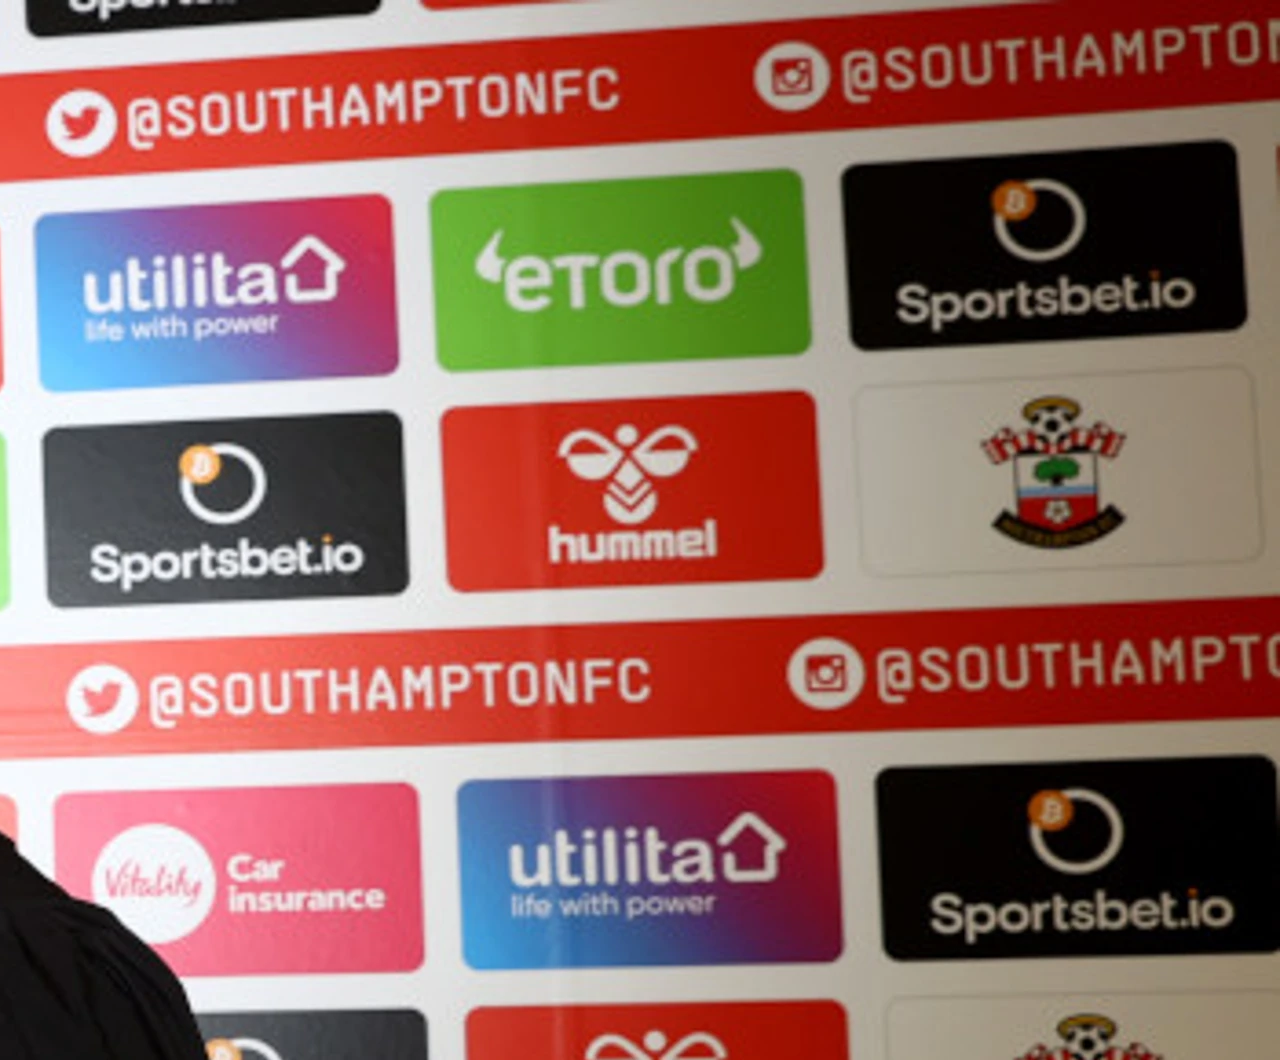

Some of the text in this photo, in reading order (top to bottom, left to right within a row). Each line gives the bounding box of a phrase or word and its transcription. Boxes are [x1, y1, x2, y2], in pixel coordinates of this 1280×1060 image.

[128, 67, 620, 149] @SOUTHAMPTONFC
[84, 253, 277, 314] utilita
[897, 271, 1195, 331] Sportsbet.io
[84, 311, 278, 341] life with power
[90, 537, 363, 592] Sportsbet.io
[548, 518, 716, 563] hummel
[149, 657, 650, 729] @SOUTHAMPTONFC
[227, 853, 284, 882] Car
[509, 827, 714, 888] utilita
[104, 864, 203, 908] Vitality
[227, 884, 385, 913] insurance
[511, 892, 717, 921] life with power
[931, 887, 1233, 944] Sportsbet.io
